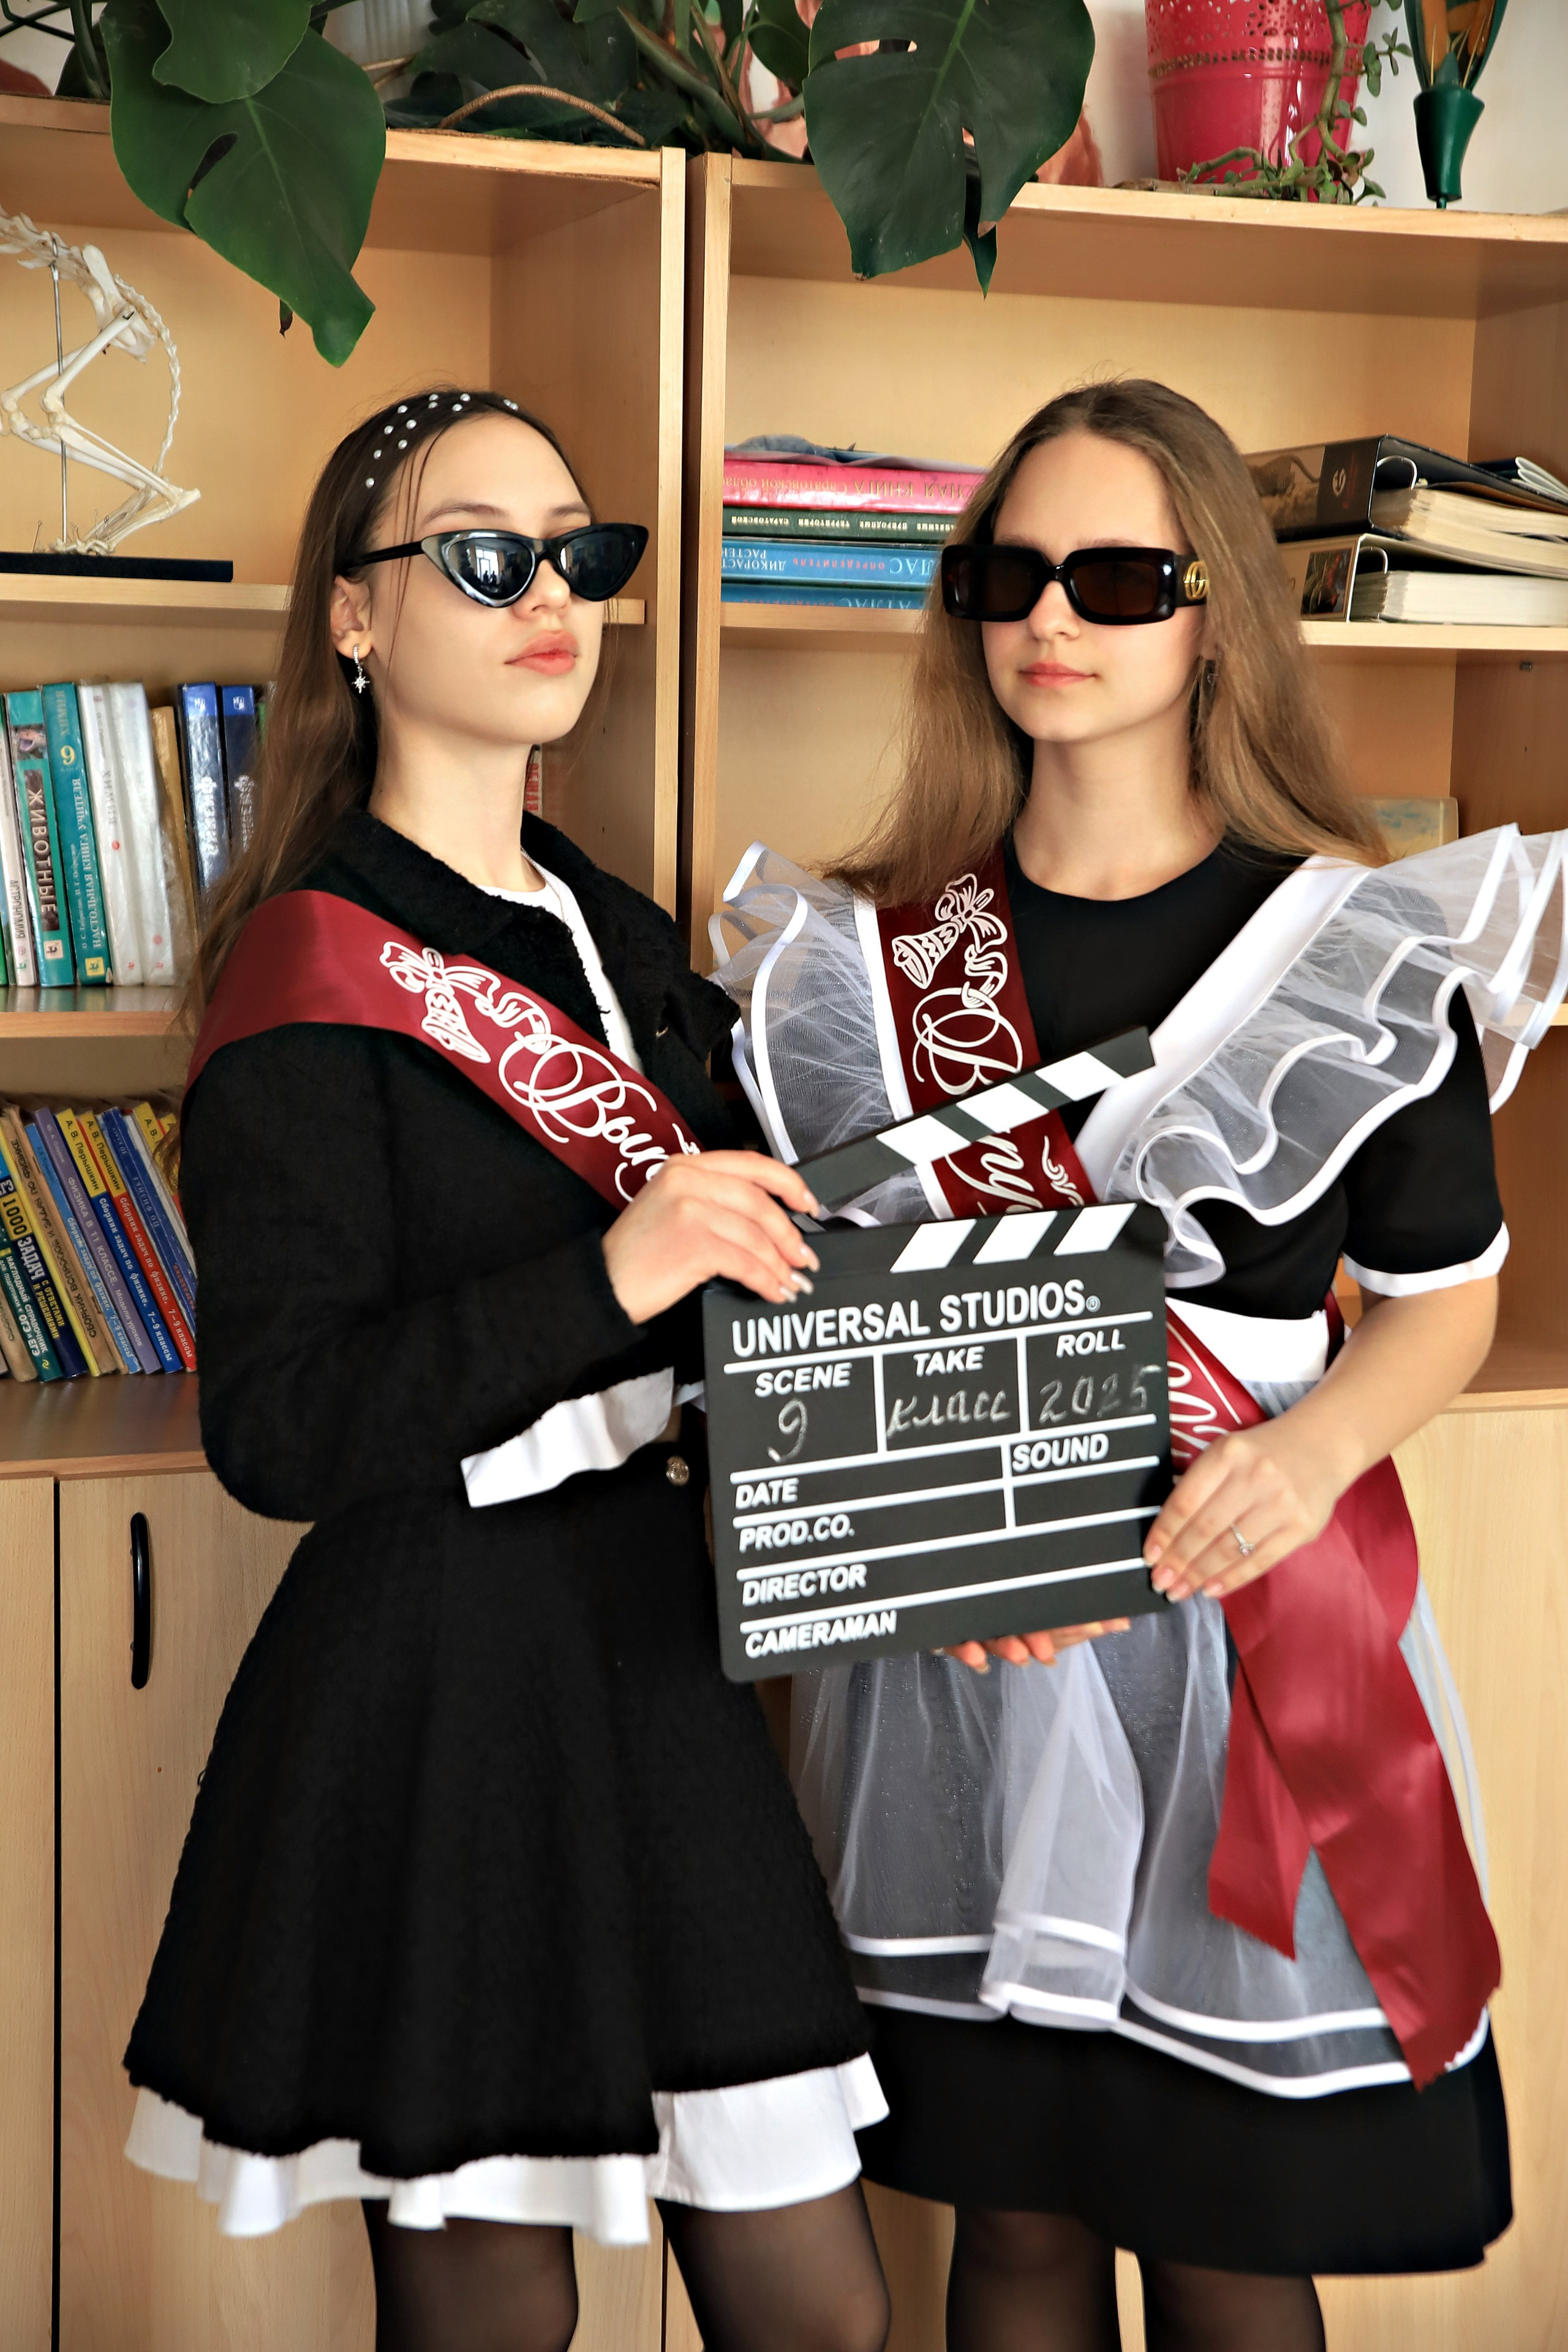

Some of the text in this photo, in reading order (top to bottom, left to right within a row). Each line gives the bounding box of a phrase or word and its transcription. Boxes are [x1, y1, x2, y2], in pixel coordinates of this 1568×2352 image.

[761, 477, 847, 496] Саратовской
[853, 480, 913, 497] КНИГА
[731, 515, 789, 526] САРАТОВСКОЙ
[797, 518, 850, 528] ТЕРРИТОРИИ
[859, 520, 907, 530] ПРИРОДНЫЕ
[721, 547, 766, 559] РАСТЕН
[721, 557, 933, 575] ЛАС ОПРЕДЕЛИТЕЛЬ ДИКОРАСТ
[60, 745, 75, 765] 9
[26, 788, 57, 913] ЖИВОТНЫЕ
[71, 777, 102, 948] НАСТОЛЬНАЯ КНИГА УЧИТЕЛЯ
[9, 1138, 32, 1179] ФИЗИКЕ
[65, 1118, 100, 1191] А. В. Перышкин
[86, 1119, 122, 1191] А. В. Перышкин
[26, 1180, 38, 1195] ПО
[1, 1197, 28, 1236] 1000
[118, 1196, 140, 1232] Сборник
[14, 1235, 46, 1281] ЗАДАЧ
[66, 1176, 89, 1218] ФИЗИКА
[89, 1230, 99, 1242] 11
[96, 1245, 118, 1286] КЛАССЕ.
[113, 1289, 132, 1320] Модели
[126, 1319, 143, 1347] уроков
[134, 1232, 149, 1257] задач
[145, 1257, 154, 1268] по
[97, 1197, 119, 1234] Сборник
[113, 1233, 129, 1257] задач
[124, 1258, 133, 1270] по
[129, 1272, 151, 1307] физике.
[154, 1330, 173, 1362] классы
[149, 1269, 171, 1305] физике.
[4, 1255, 49, 1352] НАГЛЯДНЫЙ СПРАВОЧНИК
[34, 1291, 61, 1339] РЕШЕНИЯМИ
[43, 1286, 66, 1327] ОТВЕТАМИ
[73, 1292, 98, 1338] СБОРНИК
[17, 1313, 32, 1333] ОГЭ
[26, 1337, 41, 1357] ЕГЭ
[175, 1327, 194, 1358] классы
[732, 1300, 930, 1358] UNIVERSAL
[1055, 1329, 1126, 1359] ROLL
[754, 1362, 852, 1397] SCENE
[913, 1346, 984, 1378] TAKE
[766, 1398, 809, 1464] 9
[1011, 1433, 1109, 1472] SOUND
[734, 1477, 799, 1510] DATE
[738, 1513, 856, 1553] PROD.CO.
[742, 1564, 868, 1607] DIRECTOR
[744, 1610, 897, 1659] CAMERAMAN
